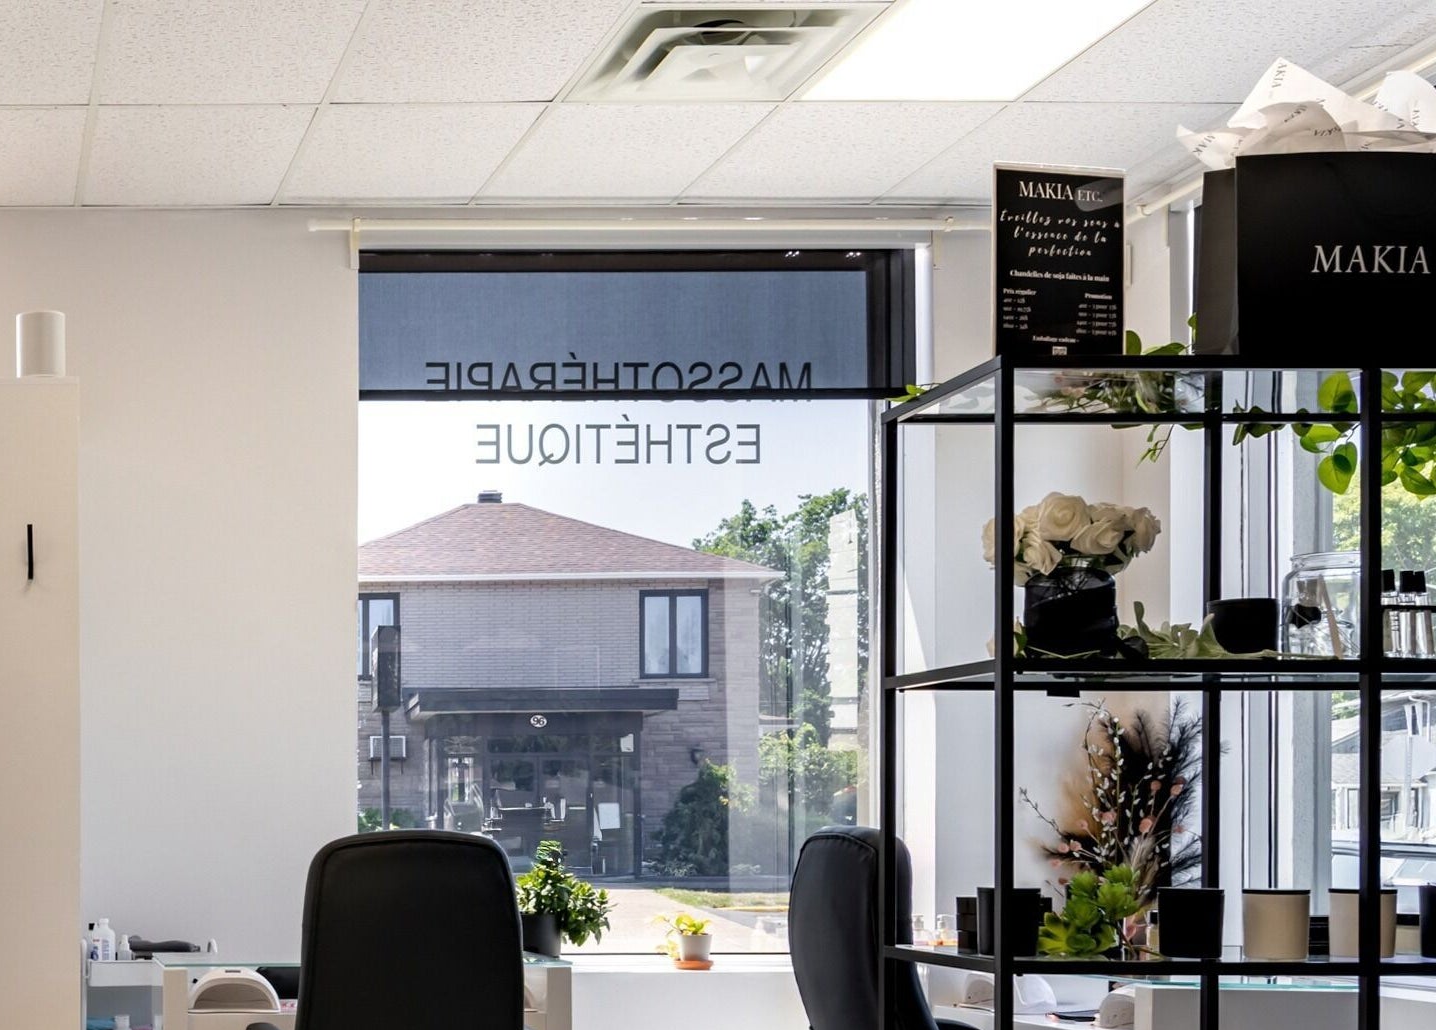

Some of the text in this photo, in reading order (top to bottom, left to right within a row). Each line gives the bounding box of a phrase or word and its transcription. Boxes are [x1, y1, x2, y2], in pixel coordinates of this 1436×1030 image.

[1019, 180, 1104, 202] MAKIA ETC.
[1074, 231, 1088, 242] de
[1094, 231, 1107, 244] la
[1028, 244, 1092, 257] perfection
[1311, 244, 1431, 274] MAKIA
[532, 716, 545, 726] 96
